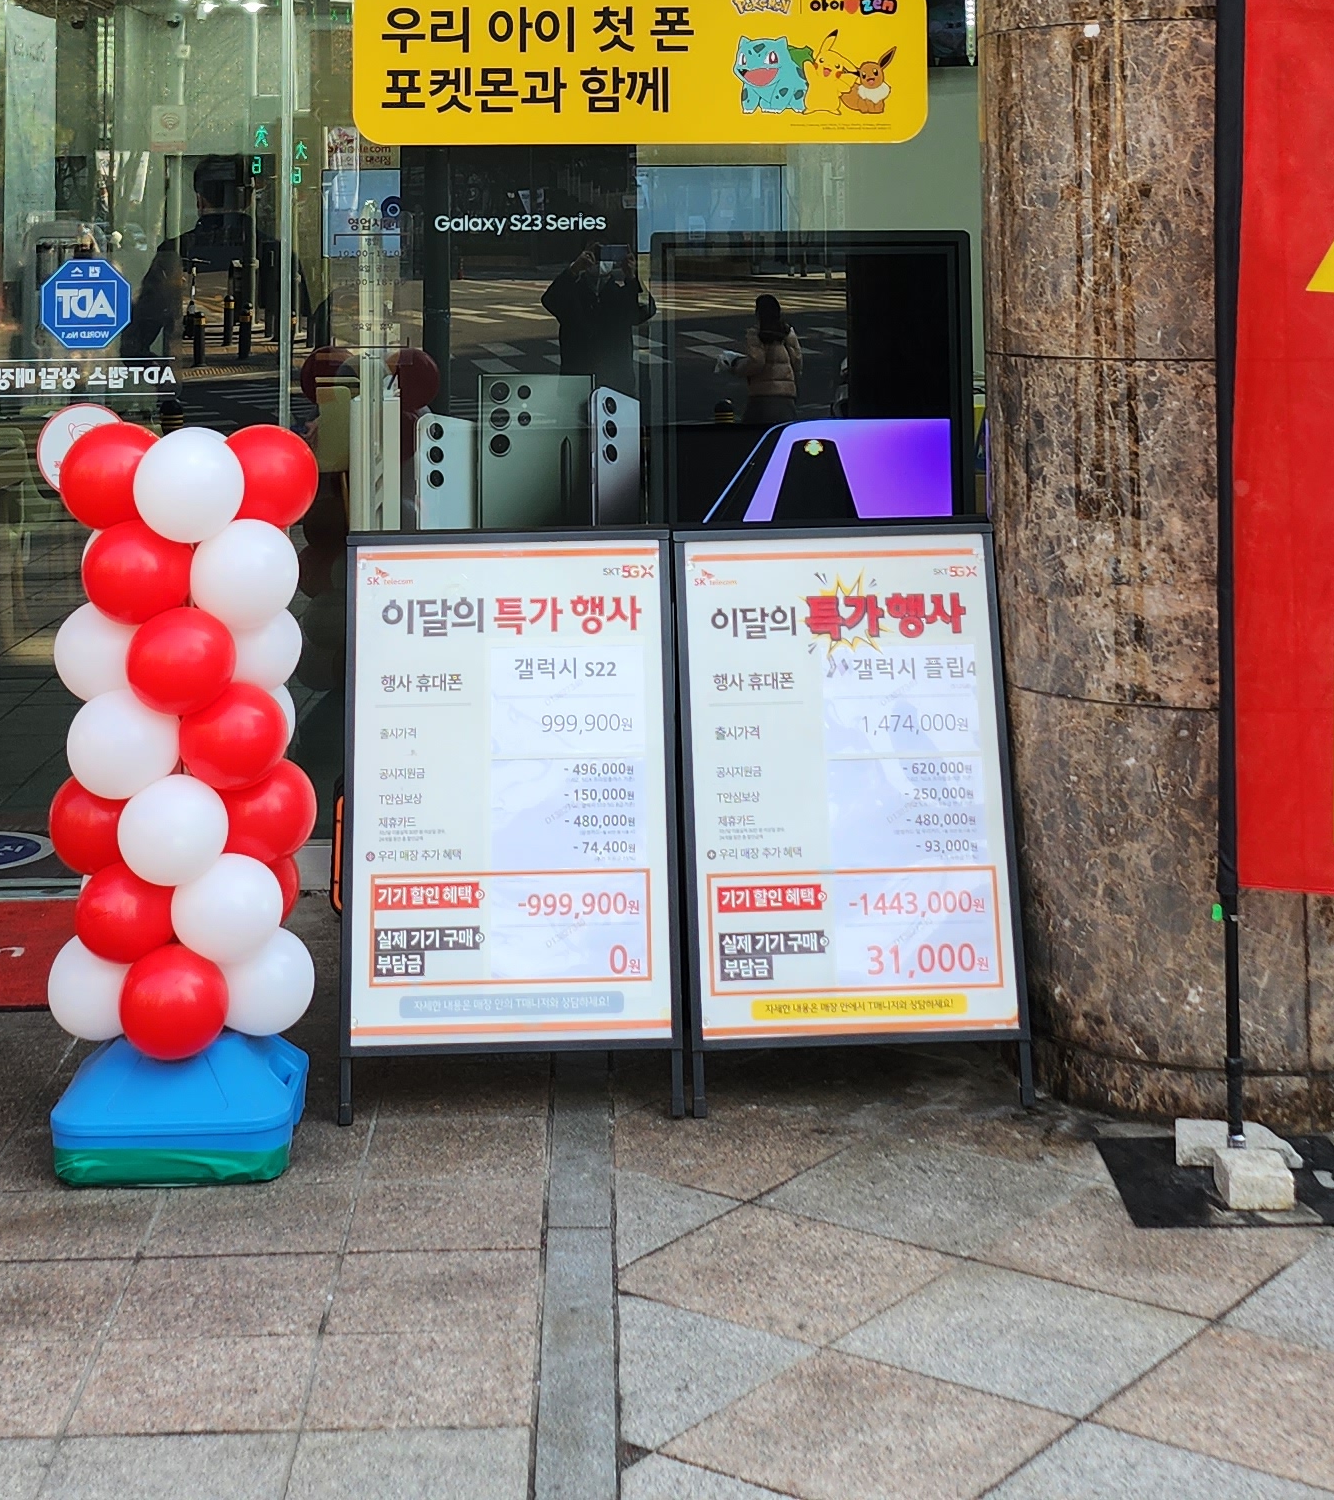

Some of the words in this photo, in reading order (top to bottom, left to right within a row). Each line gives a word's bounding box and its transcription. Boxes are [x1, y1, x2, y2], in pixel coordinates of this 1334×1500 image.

[381, 6, 470, 54] 우리
[488, 6, 577, 54] 아이
[591, 6, 636, 53] 첫
[649, 6, 696, 53] 폰
[380, 66, 567, 114] 포켓몬과
[578, 65, 670, 115] 함께
[434, 213, 507, 236] Galaxy
[509, 214, 542, 232] S23
[545, 211, 607, 232] Series
[381, 596, 484, 637] 이달의
[493, 596, 563, 636] 특가
[570, 595, 642, 635] 행사
[710, 605, 797, 640] 이달의
[805, 595, 884, 641] 특가
[885, 592, 966, 638] 행사
[514, 657, 578, 680] 갤럭시
[584, 661, 617, 677] S22
[853, 657, 917, 680] 갤럭시
[380, 673, 412, 693] 행사
[416, 672, 463, 693] 휴대폰
[712, 672, 744, 692] 행사
[748, 671, 795, 691] 휴대폰
[541, 713, 633, 735] 999,900원
[861, 713, 969, 736] 1,474,000원
[379, 767, 425, 781] 공시지원금
[716, 765, 762, 778] 공시지원금
[378, 887, 407, 906] 기기
[410, 886, 440, 905] 할인
[442, 885, 473, 904] 혜택
[517, 891, 640, 920] -999,900원
[721, 890, 750, 908] 기기
[753, 889, 783, 907] 할인
[786, 887, 816, 906] 혜택
[377, 930, 407, 950] 실제
[410, 929, 441, 949] 기기
[443, 928, 474, 948] 구매
[721, 934, 752, 954] 실제
[755, 933, 785, 953] 기기
[787, 932, 818, 952] 구매
[376, 954, 423, 975] 부담금
[608, 944, 641, 975] 0원
[724, 958, 770, 979] 부담금
[867, 943, 989, 979] 31,000원
